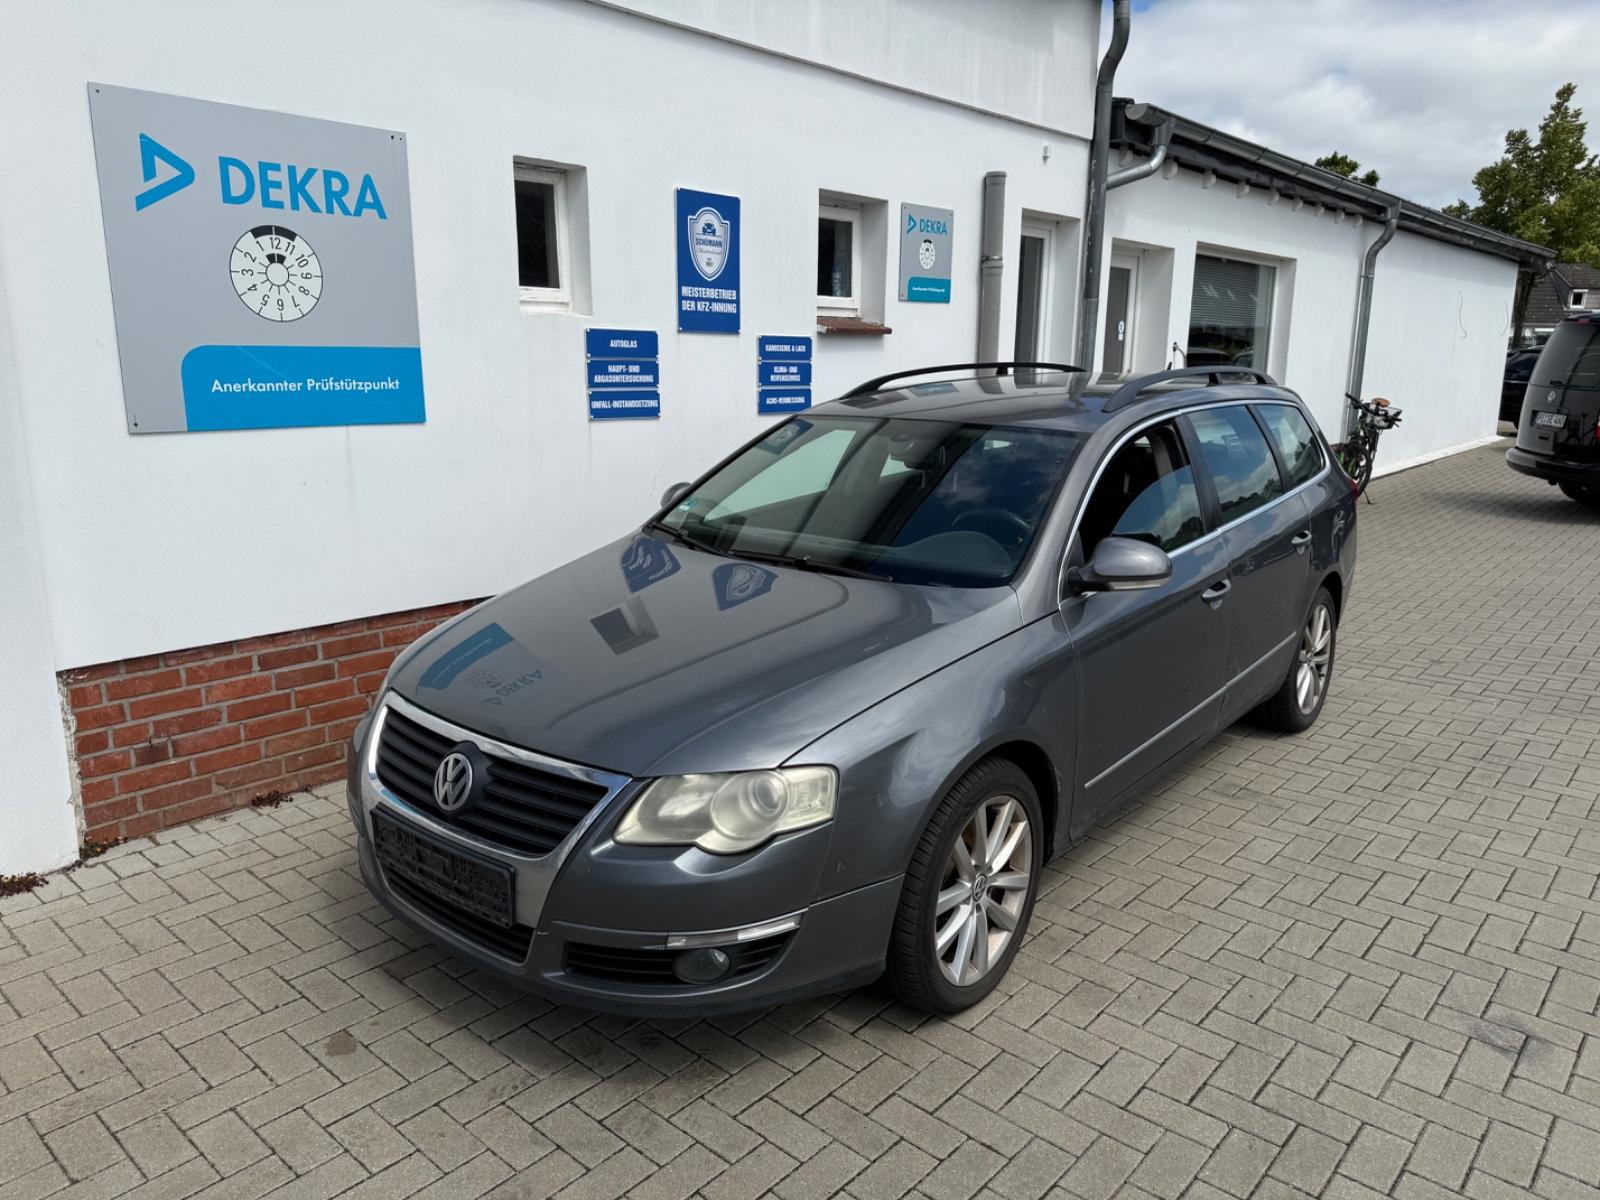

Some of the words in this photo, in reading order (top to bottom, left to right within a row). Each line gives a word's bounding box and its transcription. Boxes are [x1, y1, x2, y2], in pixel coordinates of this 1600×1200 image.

[218, 155, 387, 220] DEKRA
[919, 218, 948, 235] DEKRA
[256, 240, 265, 252] 1
[269, 236, 282, 250] 12
[285, 241, 296, 255] 11
[243, 251, 257, 263] 2
[295, 253, 309, 268] 10
[241, 268, 254, 277] 3
[300, 272, 313, 280] 9
[247, 283, 258, 291] 4
[298, 285, 310, 296] 8
[681, 285, 737, 300] MEISTERBETRIEB
[260, 294, 270, 306] 5
[277, 298, 284, 311] 6
[291, 295, 300, 308] 7
[681, 299, 696, 311] DER
[697, 301, 737, 314] KFZ-INNUNG
[610, 339, 638, 348] AUTOGLAS
[628, 364, 640, 373] UND
[211, 378, 303, 393] Anerkannter
[306, 376, 401, 394] Prüfstützpunkt
